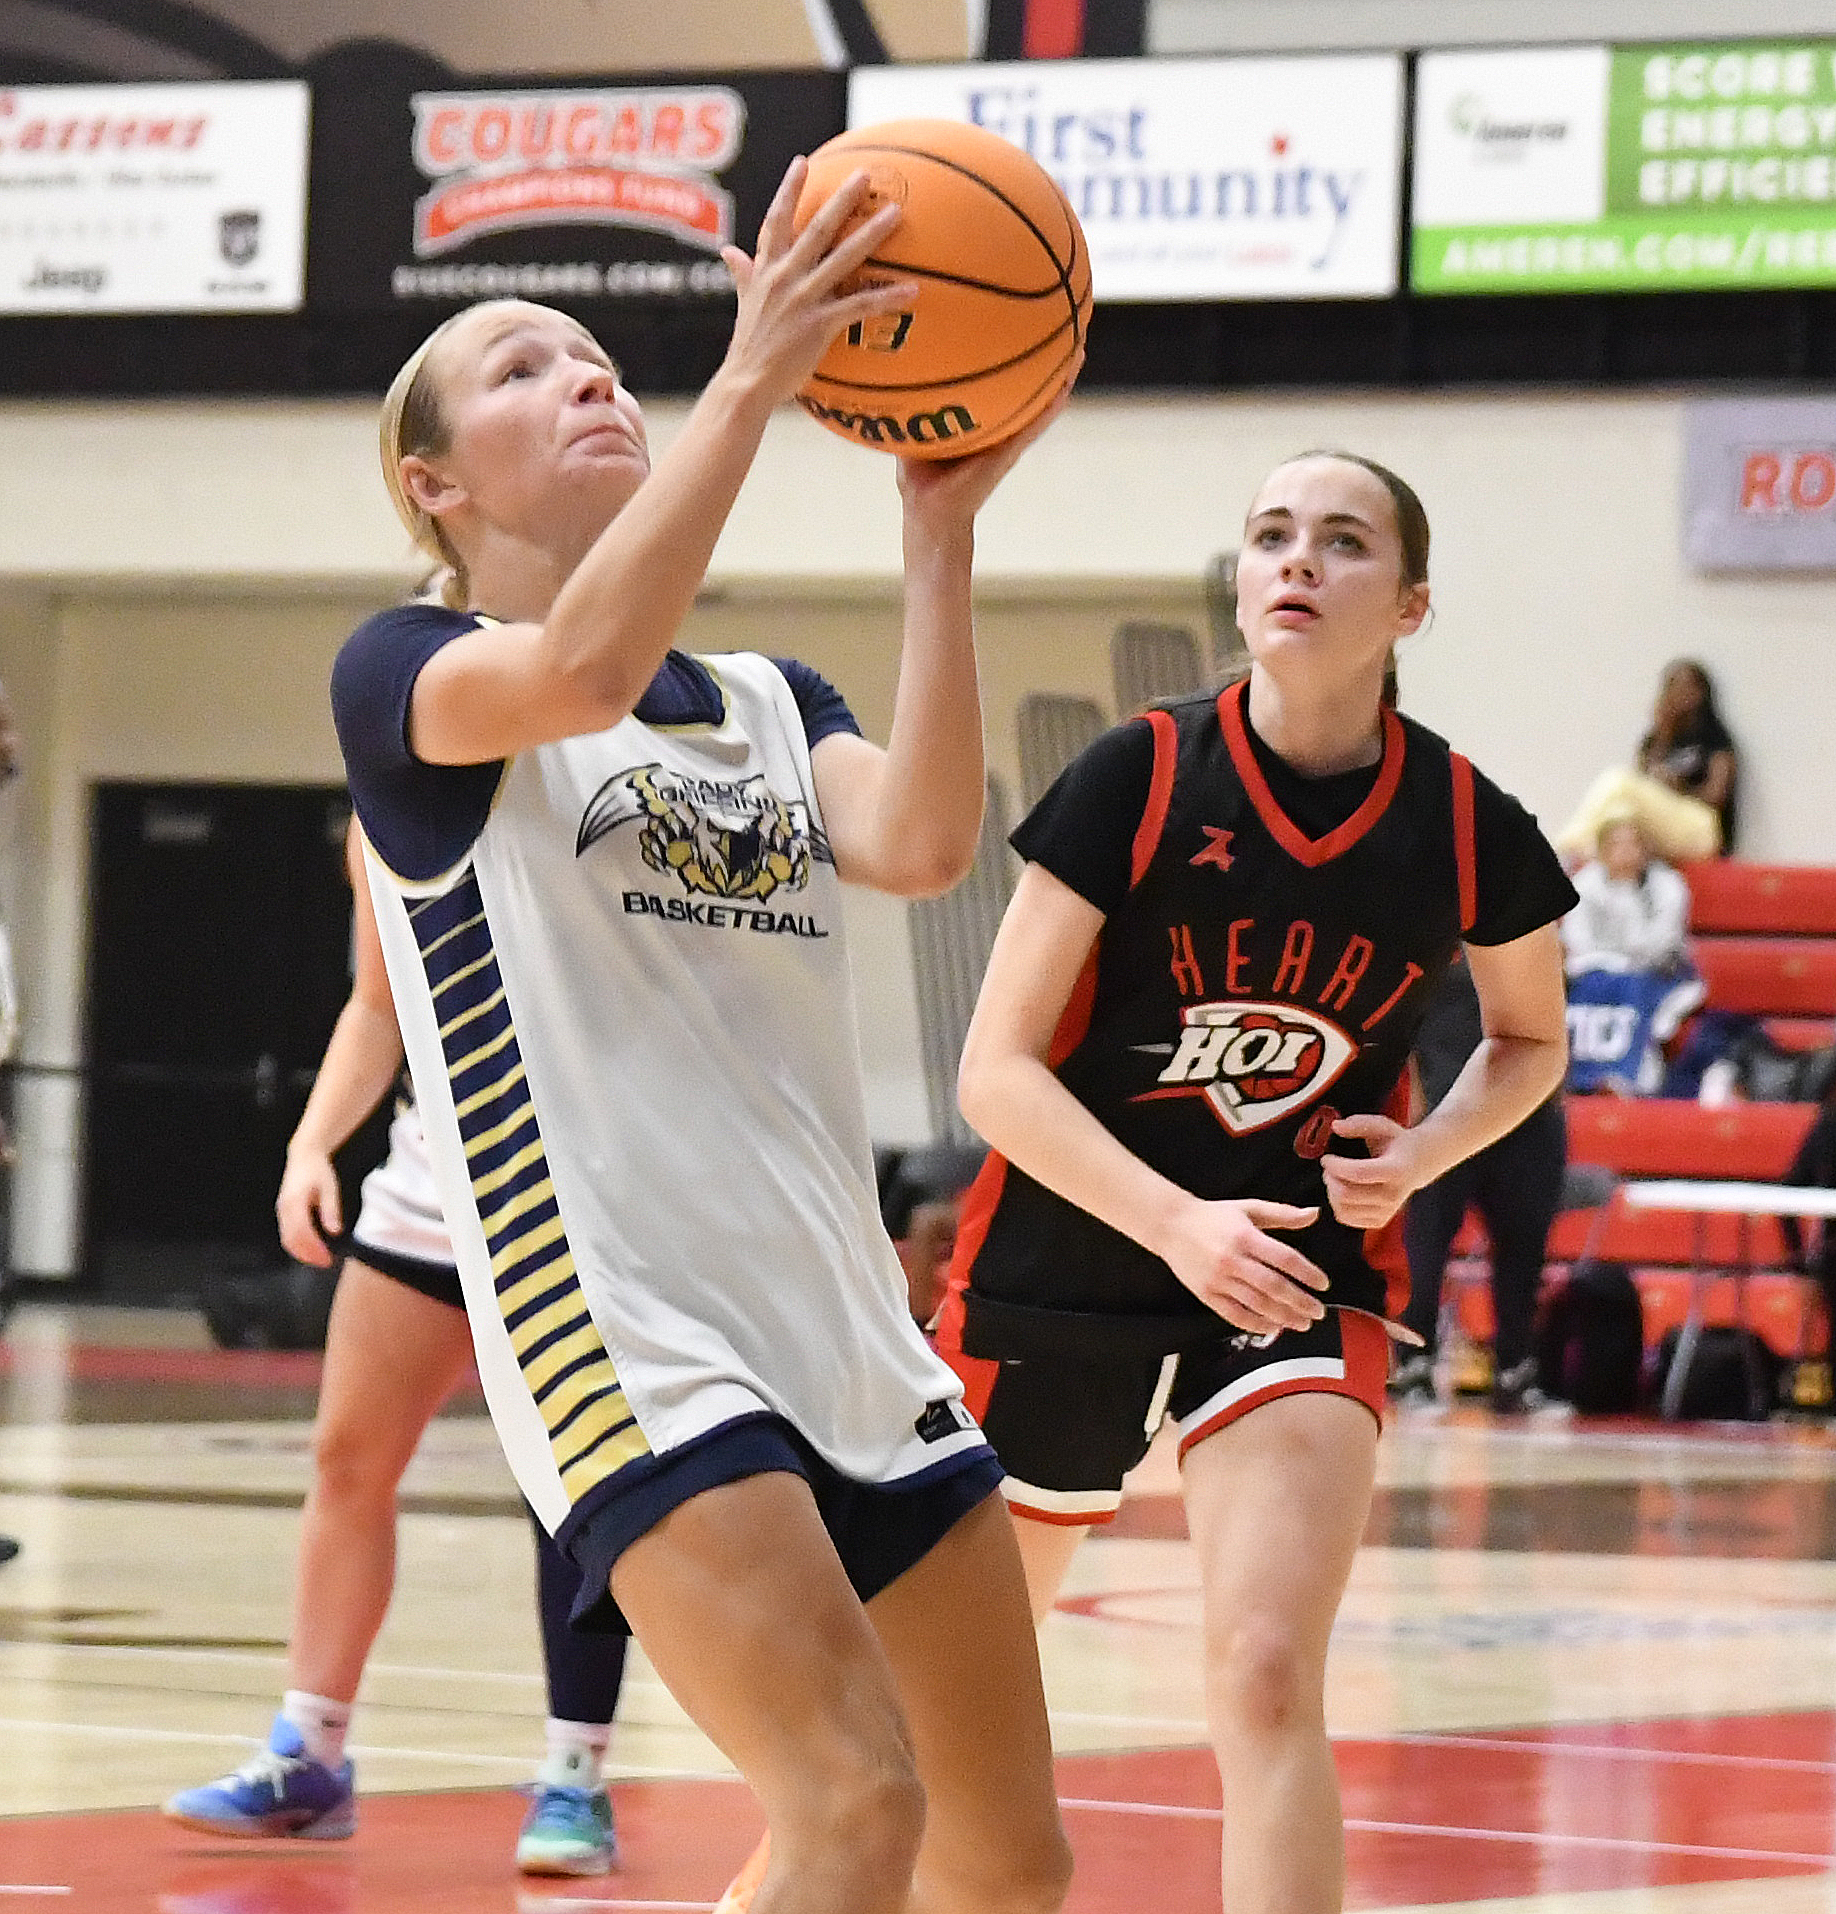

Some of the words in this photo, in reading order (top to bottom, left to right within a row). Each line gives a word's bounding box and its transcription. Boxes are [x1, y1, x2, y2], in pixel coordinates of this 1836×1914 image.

[1643, 52, 1816, 100] SCORE
[425, 101, 733, 164] COUGARS
[964, 86, 1145, 161] First
[1640, 104, 1836, 152] ENERGY
[1060, 136, 1366, 272] munity
[1639, 157, 1836, 204] EFFICIE
[621, 890, 829, 938] BASKETBALL
[1167, 918, 1425, 1032] HEART
[1156, 1022, 1319, 1082] HOI
